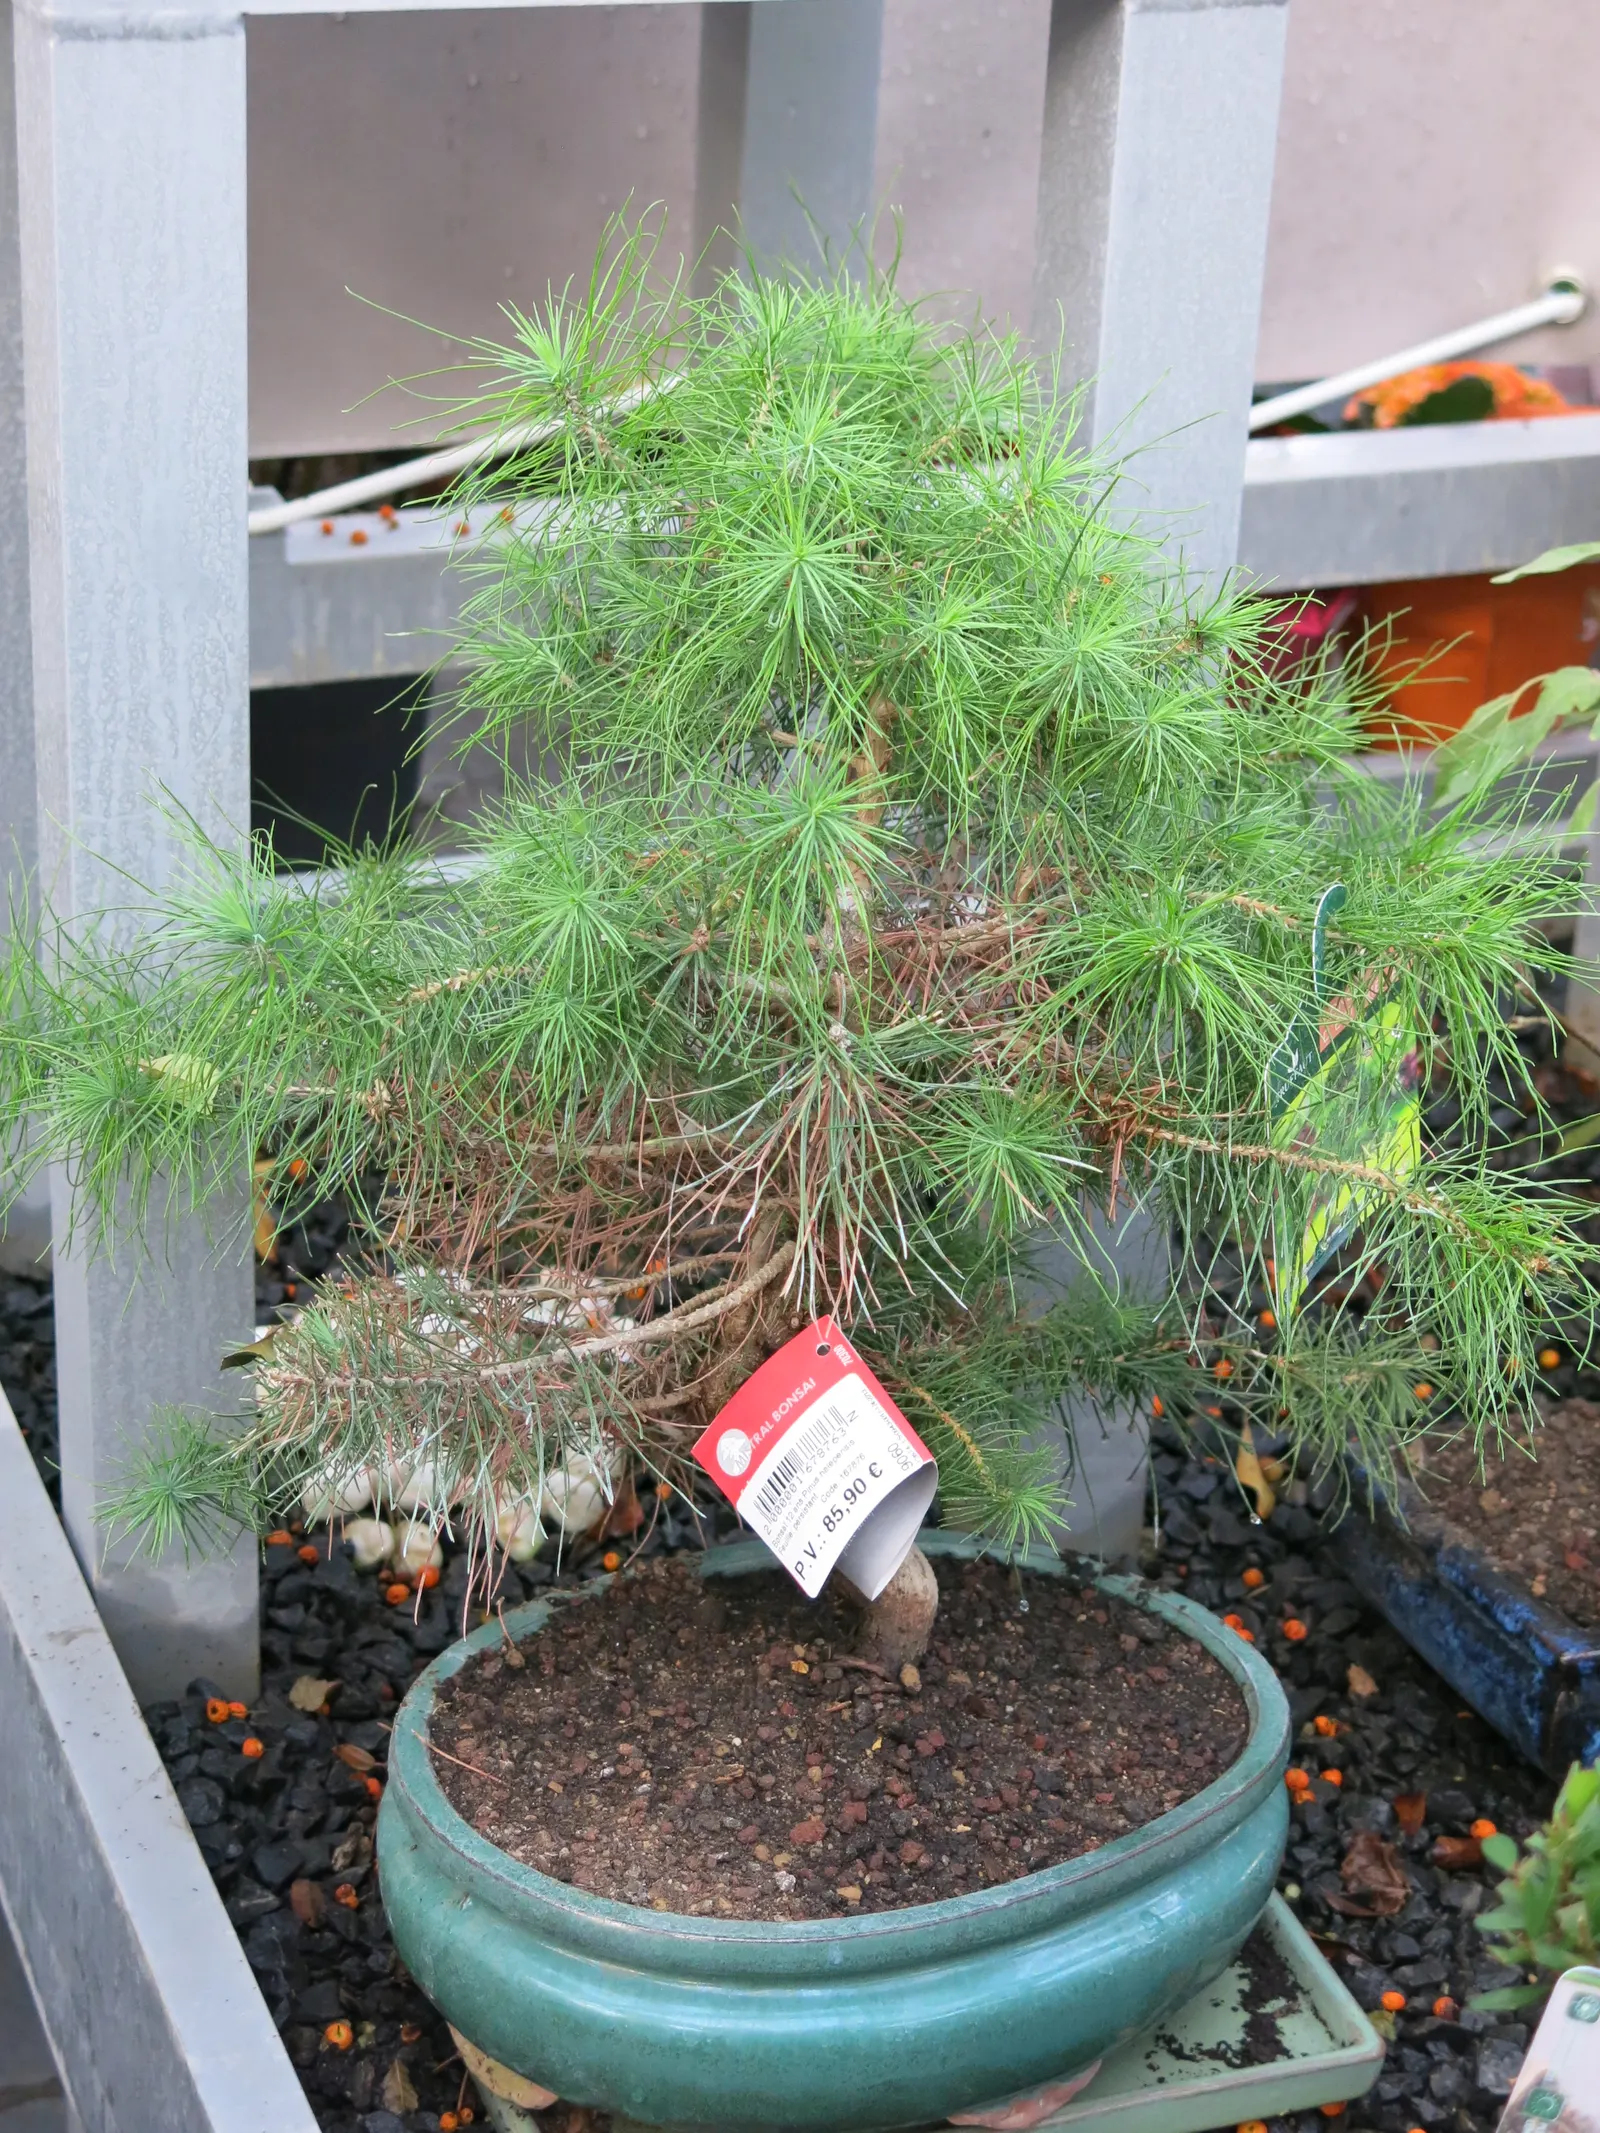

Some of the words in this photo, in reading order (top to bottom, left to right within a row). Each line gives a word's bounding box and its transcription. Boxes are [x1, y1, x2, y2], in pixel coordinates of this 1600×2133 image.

[771, 1377, 817, 1422] BONSAI
[805, 1427, 847, 1474] 678763
[786, 1510, 795, 1523] 12
[793, 1498, 805, 1512] ans
[801, 1476, 820, 1498] Pinus
[822, 1477, 867, 1533] 85,90
[868, 1461, 883, 1479] €
